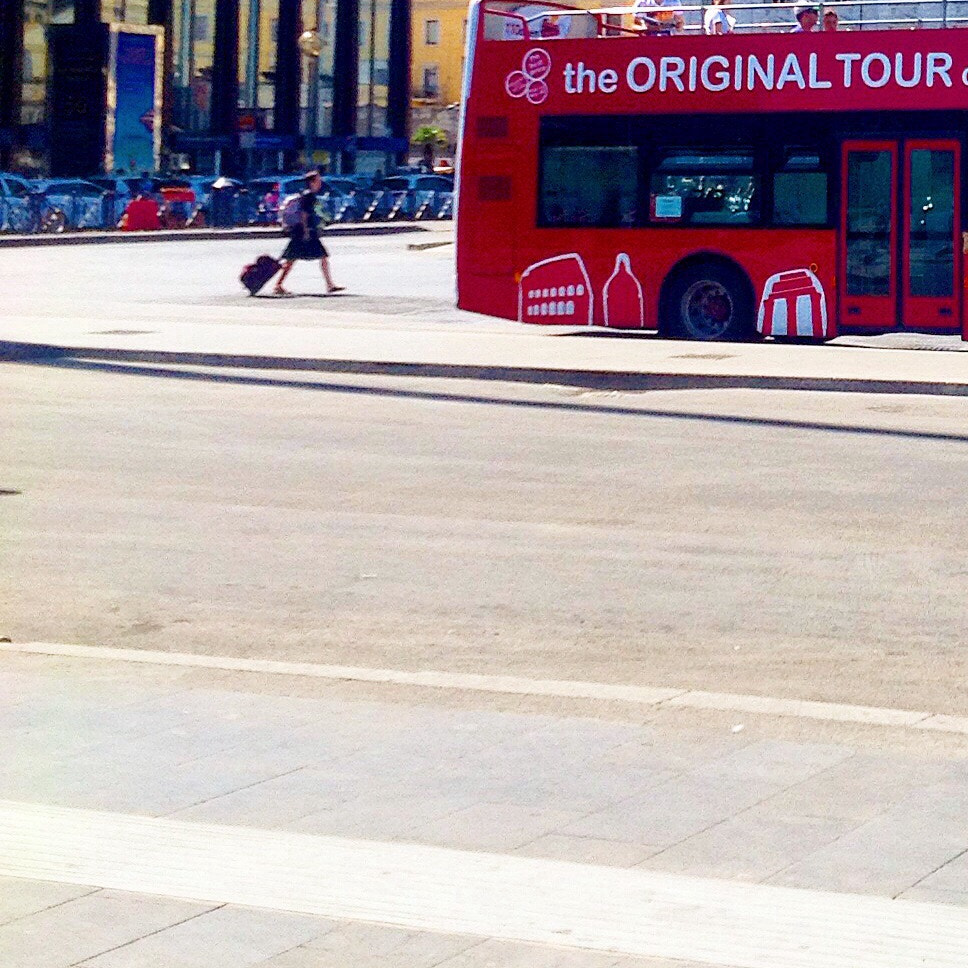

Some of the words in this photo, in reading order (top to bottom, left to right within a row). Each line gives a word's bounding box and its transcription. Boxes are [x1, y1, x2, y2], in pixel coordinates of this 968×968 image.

[563, 62, 618, 93] the
[626, 52, 832, 92] ORIGINAL
[836, 52, 953, 88] TOUR
